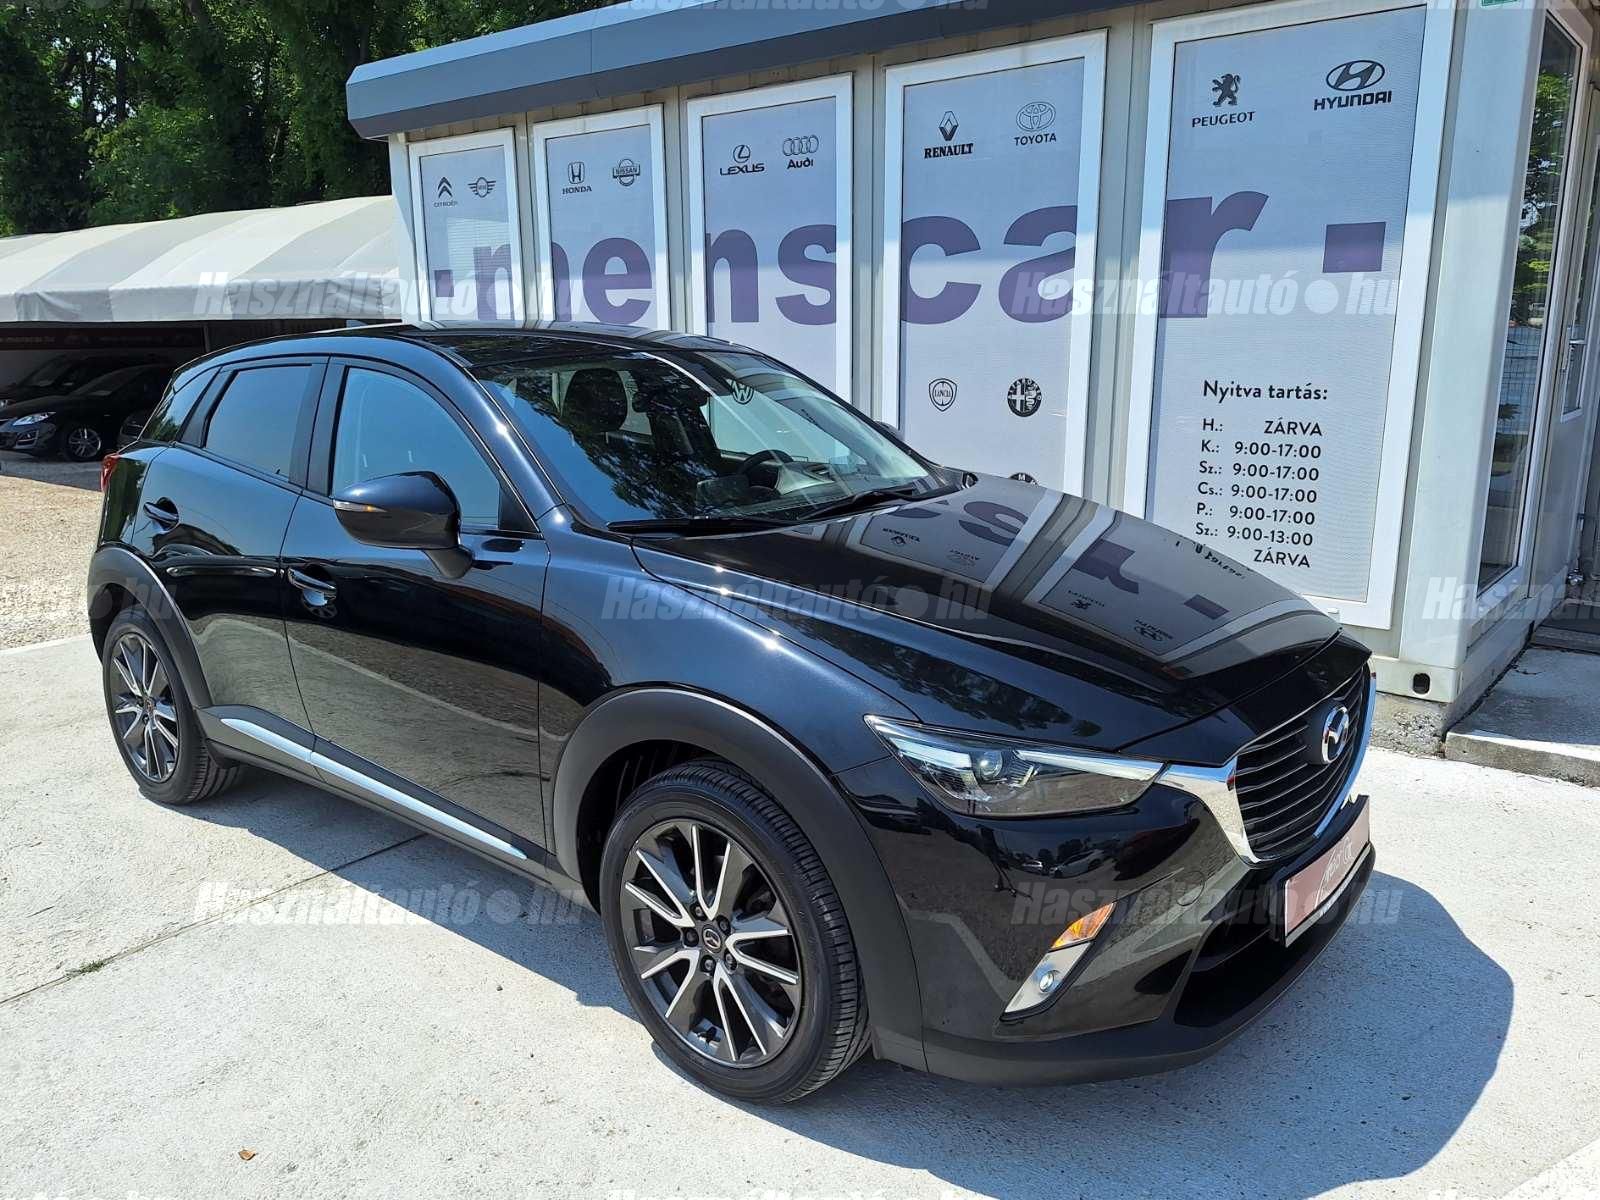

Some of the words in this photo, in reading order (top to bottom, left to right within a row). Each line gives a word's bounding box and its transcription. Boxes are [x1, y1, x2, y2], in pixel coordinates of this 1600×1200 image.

[1313, 91, 1392, 111] HYUNDAI
[1191, 111, 1256, 128] PEUGEOT
[1014, 133, 1057, 146] TOYOTA
[924, 143, 974, 159] RENAULT
[719, 163, 765, 176] LEXUS
[786, 157, 814, 170] Audi
[562, 185, 592, 195] HONDA
[1203, 379, 1262, 403] Nyitva
[1268, 382, 1328, 400] tartás:
[1202, 418, 1223, 432] H.:
[1263, 417, 1323, 437] ZÁRVA
[1201, 439, 1220, 453] K.:
[1234, 441, 1322, 459] 9:00-17:00
[1199, 461, 1222, 475] Sz.:
[1232, 462, 1319, 481] 9:00-17:00
[1197, 481, 1223, 496] Cs.:
[1231, 484, 1317, 503] 9:00-17:00
[1196, 502, 1213, 516] P.:
[1229, 505, 1315, 525] 9:00-17:00
[1195, 522, 1218, 537] Sz.:
[1227, 525, 1313, 546] 9:00-13:00
[1253, 547, 1311, 568] ZÁRVA
